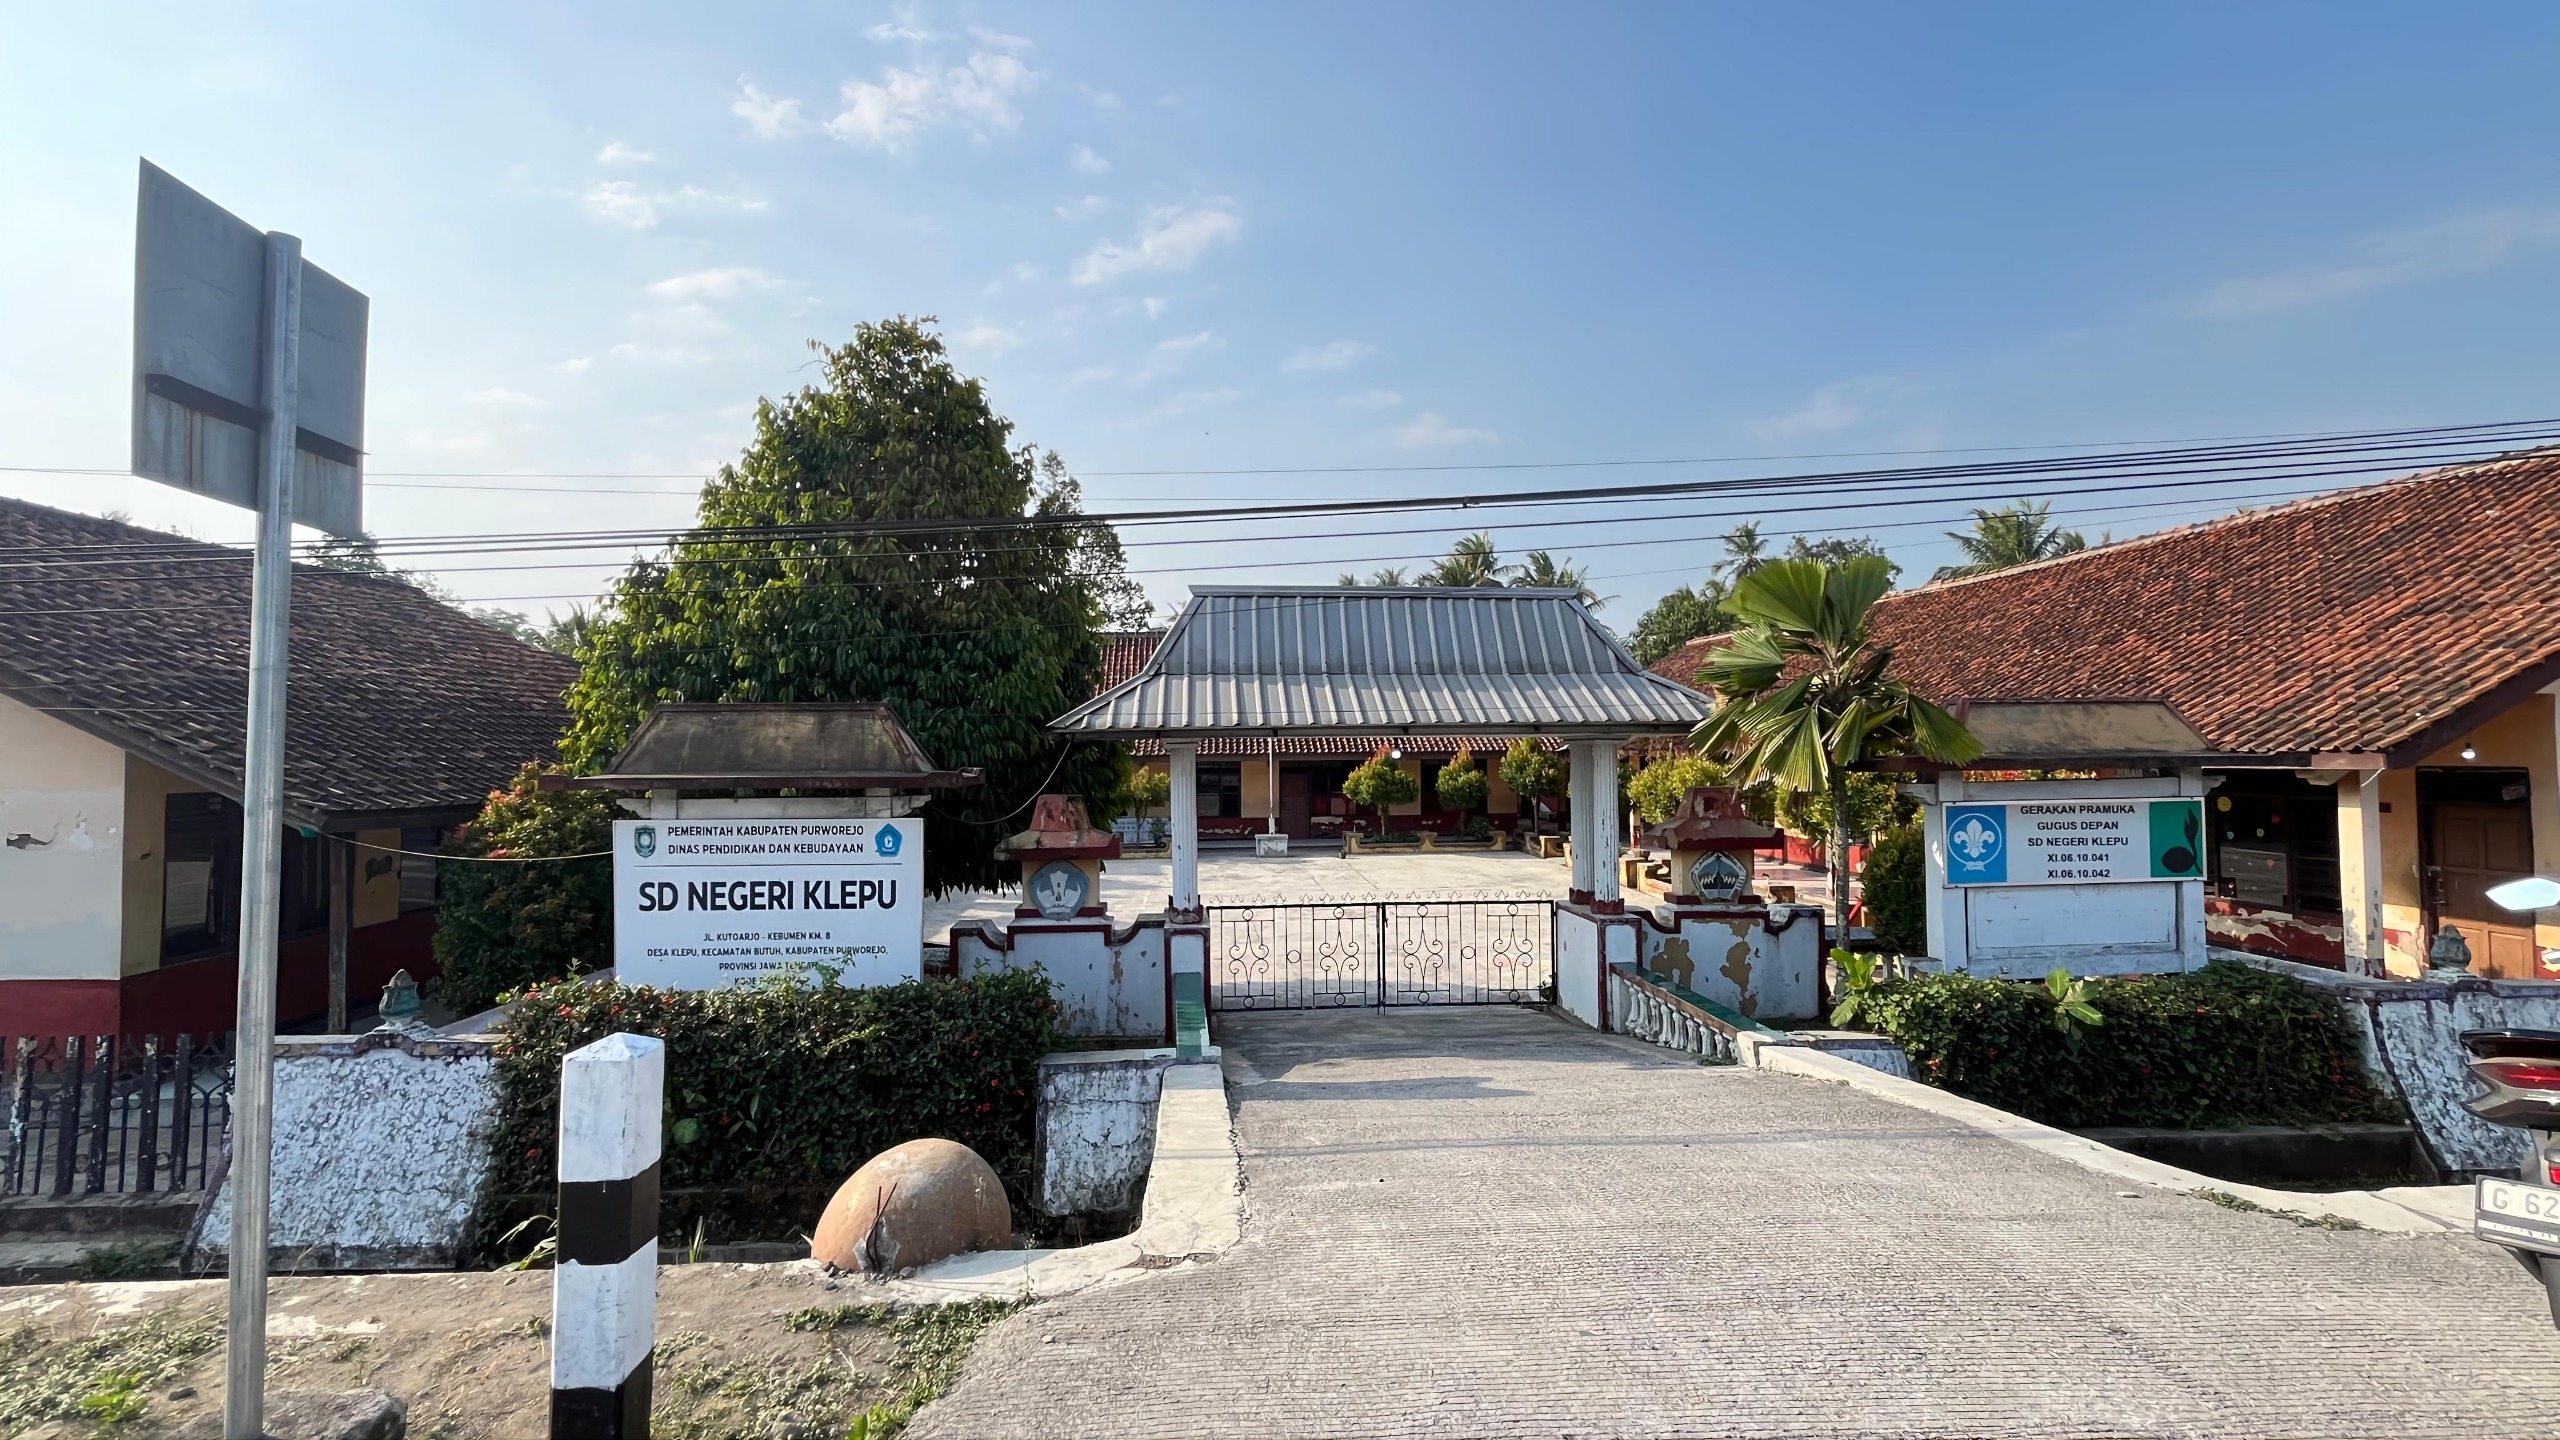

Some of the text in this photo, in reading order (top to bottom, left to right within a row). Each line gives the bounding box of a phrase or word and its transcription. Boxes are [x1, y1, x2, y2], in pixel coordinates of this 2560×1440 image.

[2020, 804, 2135, 815] GERAKAN PRAMUKA
[668, 824, 864, 837] PEMERINTAH KABUPATEN PURWOREJO
[2037, 821, 2119, 831] GUGUS DEPAN
[2027, 836, 2129, 847] SD NEGERI KLEPU
[668, 842, 864, 855] DINAS PENDIDIKAN DAN KEBUDAYAAN
[2047, 853, 2109, 863] XI.06.10.041
[2047, 869, 2110, 879] XI.06.10.042
[638, 879, 897, 912] SD NEGERI KLEPU
[703, 933, 715, 942] JL.
[716, 932, 760, 941] KUTOARJO
[767, 932, 807, 941] KEBUMEN
[808, 931, 823, 940] KM.
[825, 931, 831, 940] 8
[647, 945, 888, 958] DESA KLEPU, KECAMATAN BUTUH, KABUPATEN PURWOREJO,
[719, 962, 757, 971] PROVINSI
[759, 961, 783, 970] JAWA
[2492, 1187, 2509, 1210] G
